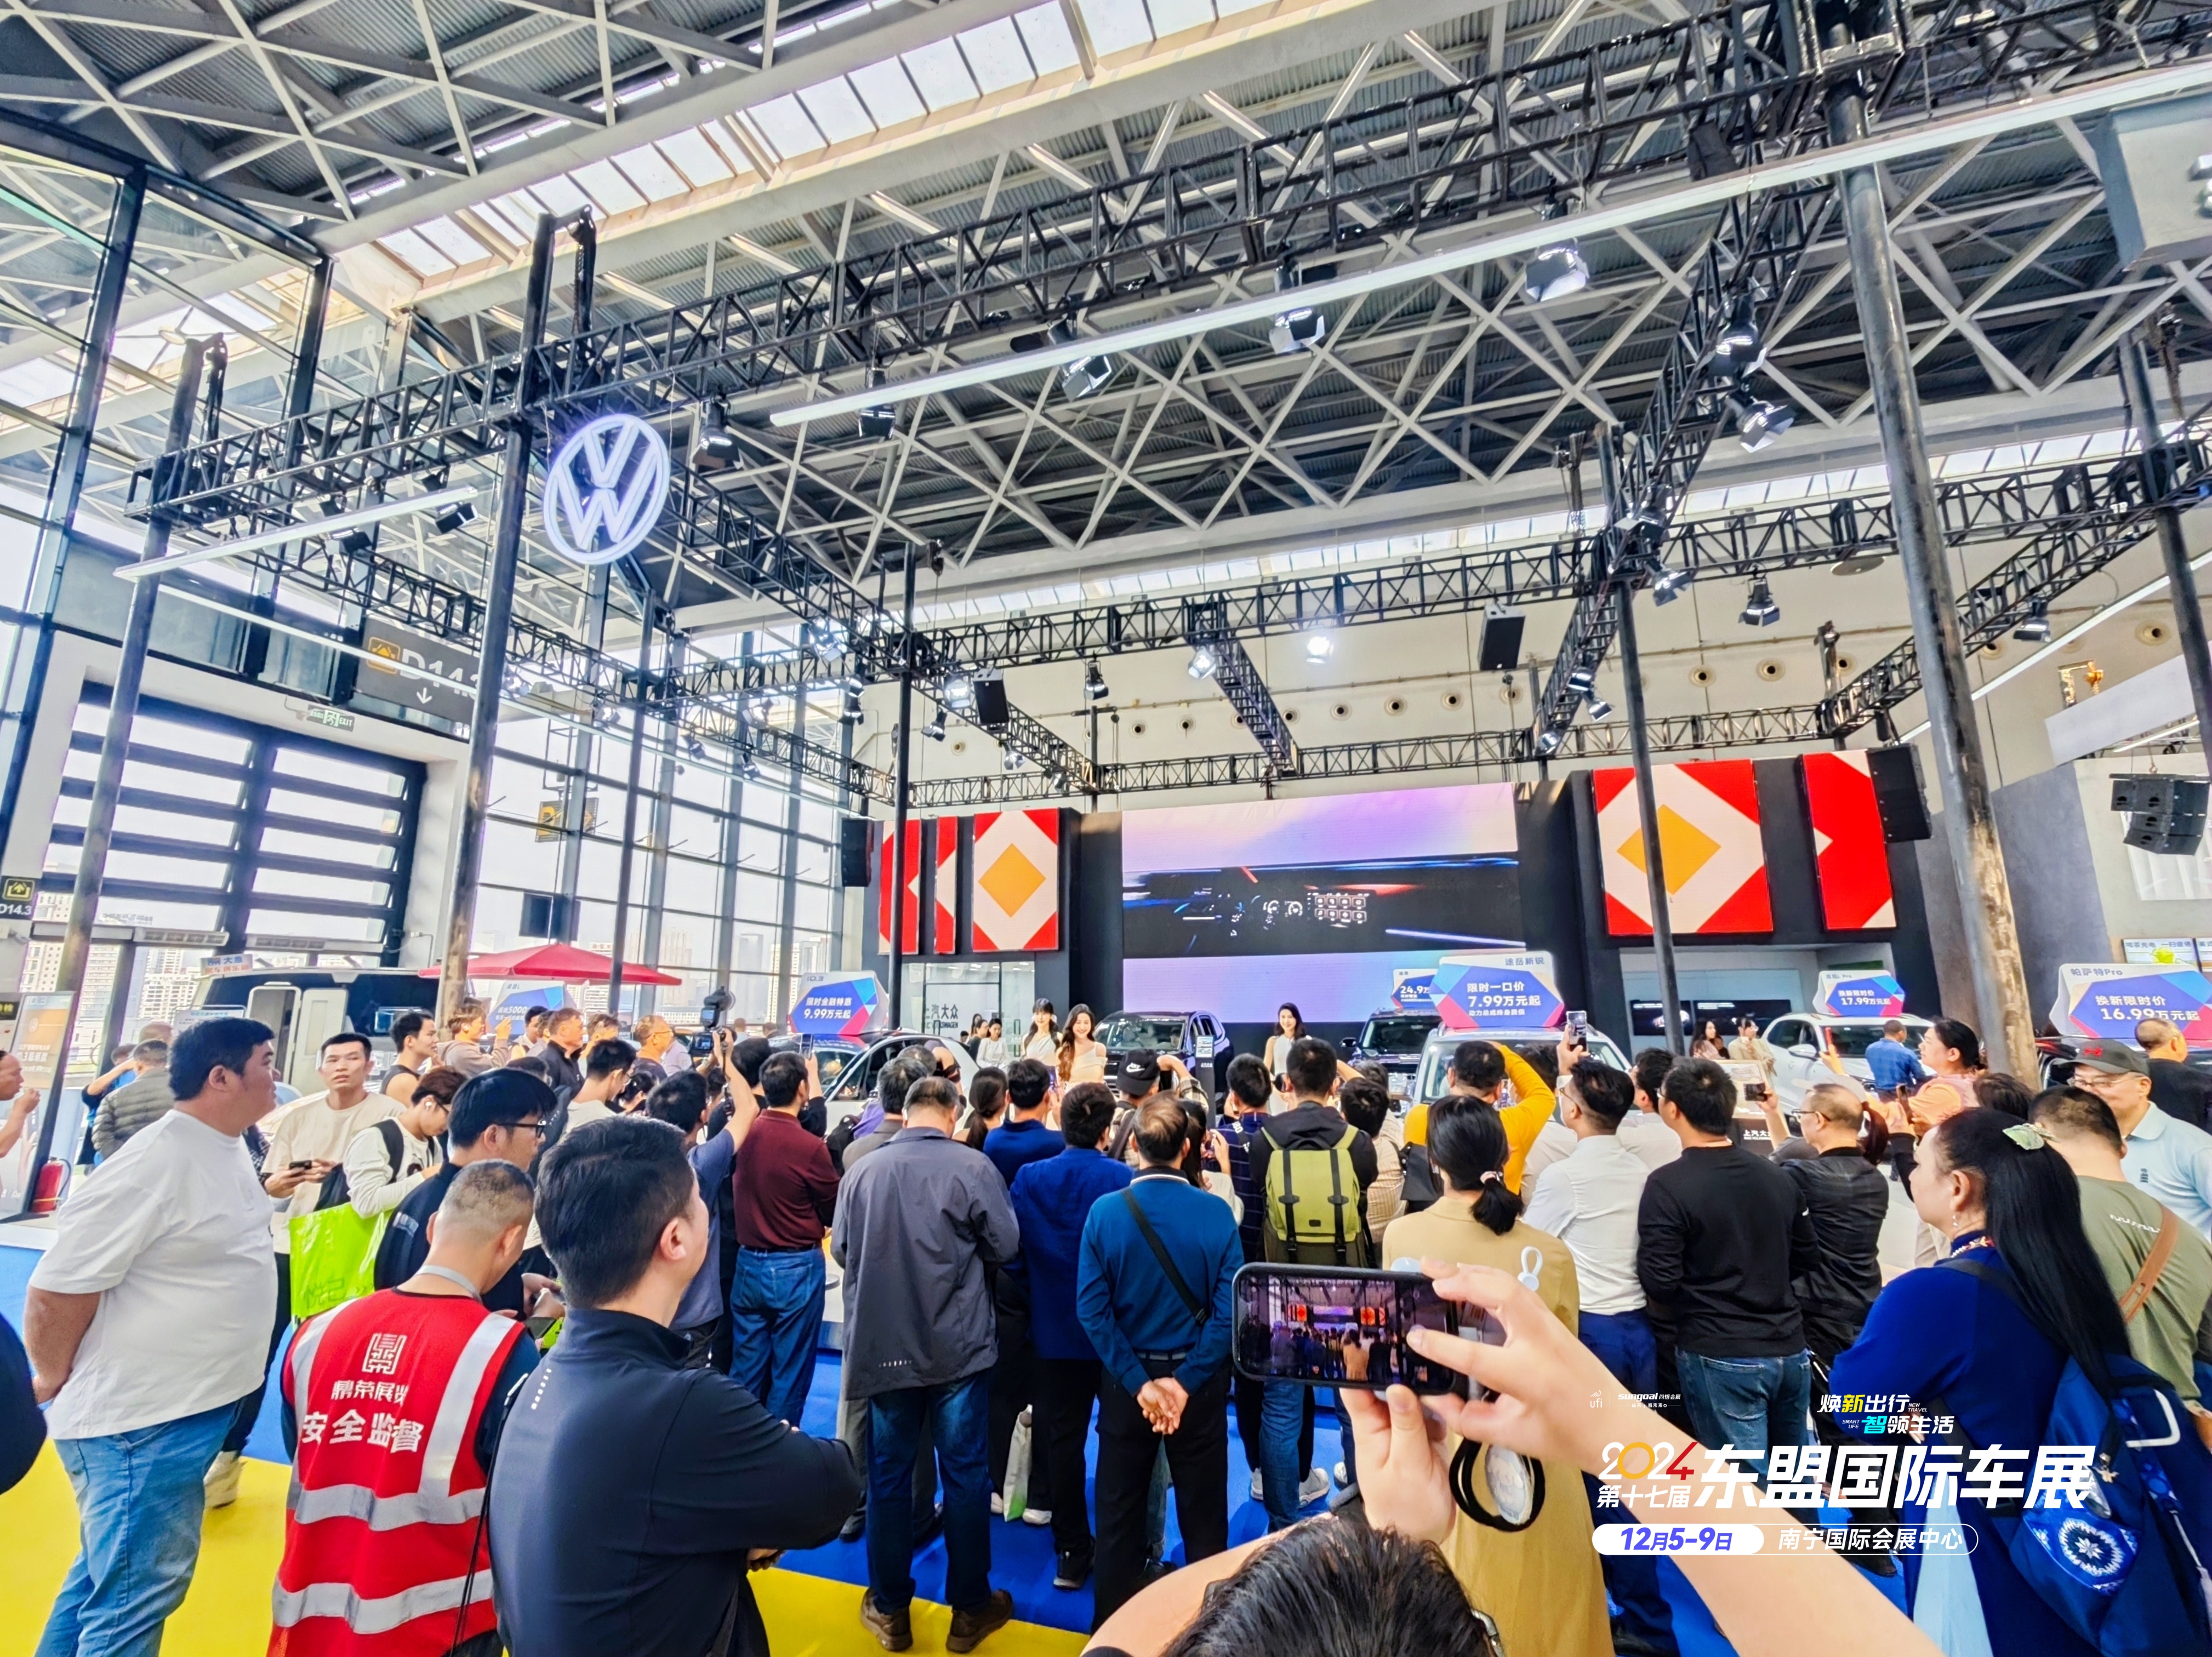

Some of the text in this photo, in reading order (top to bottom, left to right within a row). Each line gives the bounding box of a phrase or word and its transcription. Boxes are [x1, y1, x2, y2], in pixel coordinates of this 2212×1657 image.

[339, 717, 352, 727] EXIT
[1505, 957, 1545, 966] 途岳新锐
[2071, 968, 2123, 976] 帕萨特Pro
[1467, 981, 1525, 993] 限时一口价
[806, 997, 852, 1006] 限时金融特惠
[1468, 995, 1541, 1008] 7.99万元起
[2095, 996, 2166, 1006] 换新限时价
[804, 1009, 851, 1019] 9.99万元起
[2100, 1008, 2202, 1021] 16.99万元起
[301, 1409, 424, 1454] 安全监督
